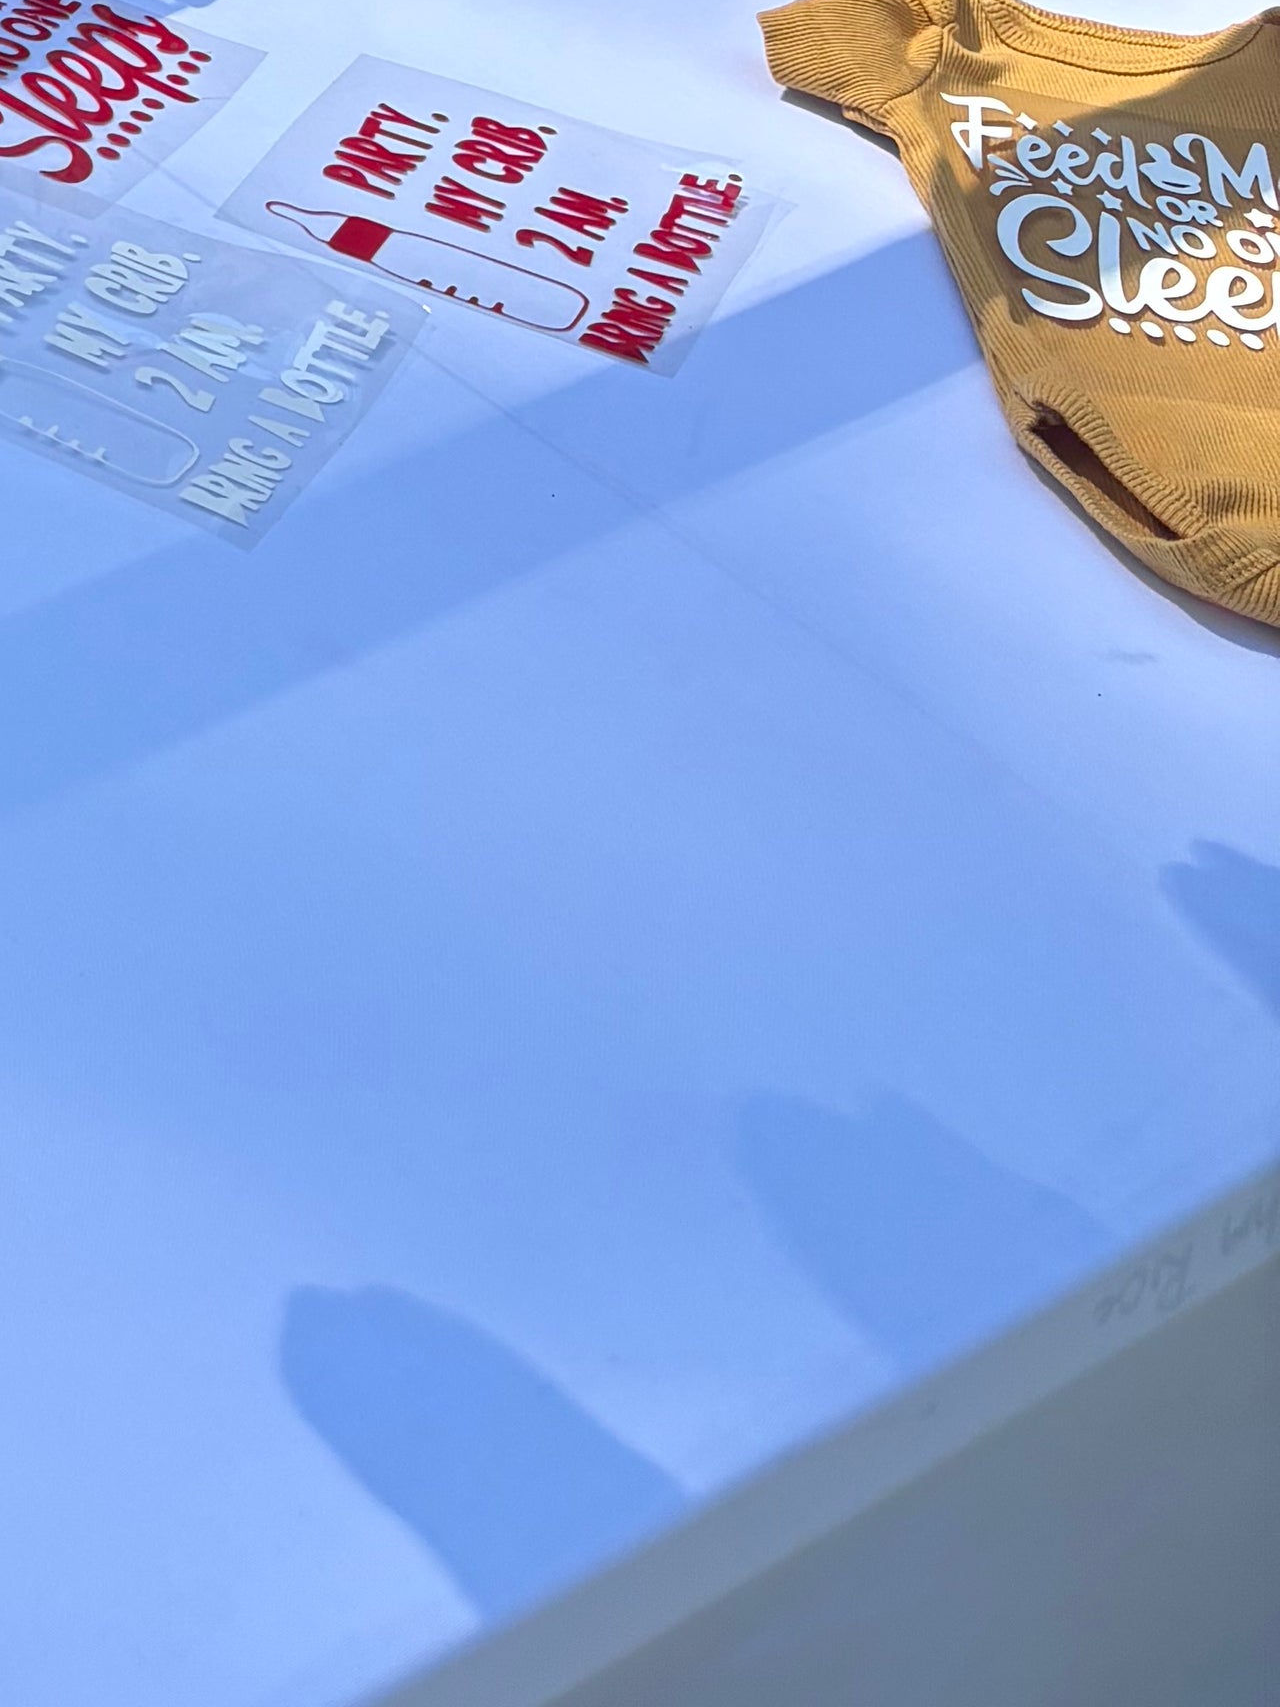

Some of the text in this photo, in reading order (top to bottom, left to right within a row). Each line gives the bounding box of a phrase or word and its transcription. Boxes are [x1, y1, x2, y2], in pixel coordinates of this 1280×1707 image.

[321, 102, 450, 201] PARTY.
[424, 115, 558, 233] MY CRIB.
[1154, 195, 1225, 228] OR
[43, 240, 203, 368] MY CRIB.
[578, 286, 677, 366] BRING
[632, 172, 743, 275] BOTTLE.
[996, 192, 1280, 333] Slee
